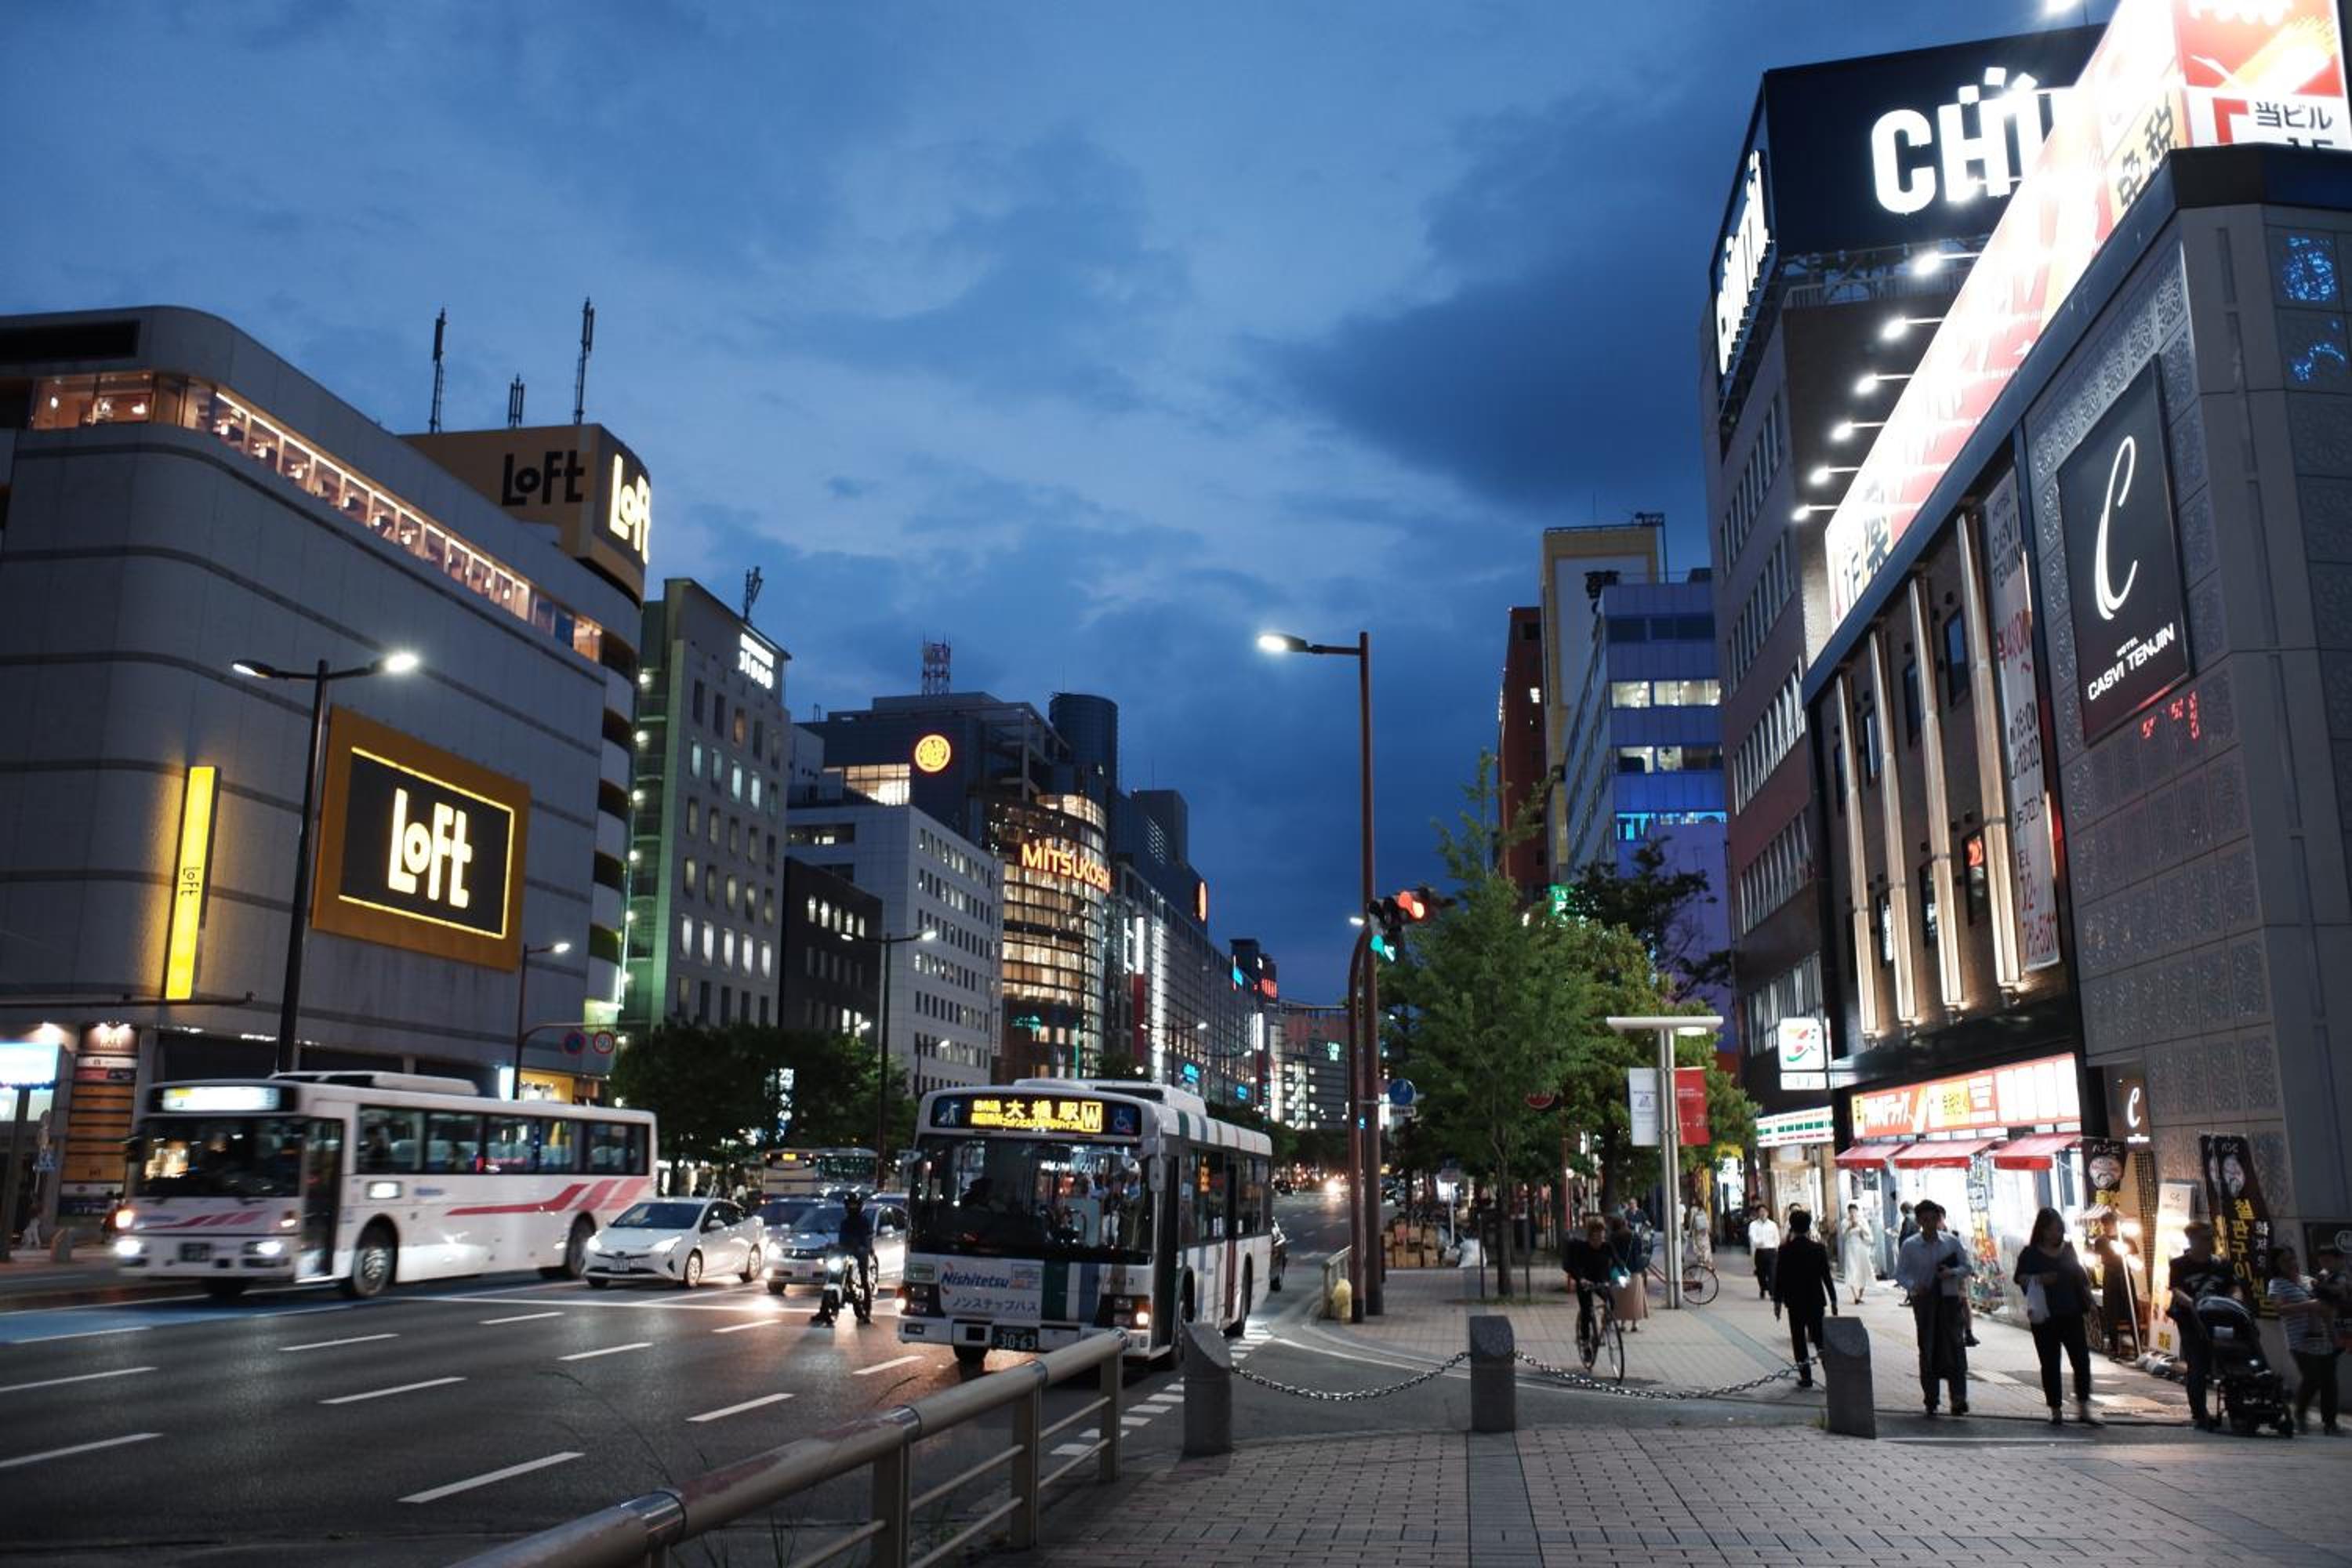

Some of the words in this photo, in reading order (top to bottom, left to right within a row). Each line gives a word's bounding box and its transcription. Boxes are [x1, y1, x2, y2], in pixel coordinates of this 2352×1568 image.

[2256, 100, 2333, 131] 当ビル
[2088, 662, 2125, 701] CASVI
[2127, 622, 2176, 671] TENJIN
[1083, 1104, 1100, 1129] W
[941, 1269, 1010, 1288] Nishitetsu
[951, 1295, 1039, 1313] ノンステップバス
